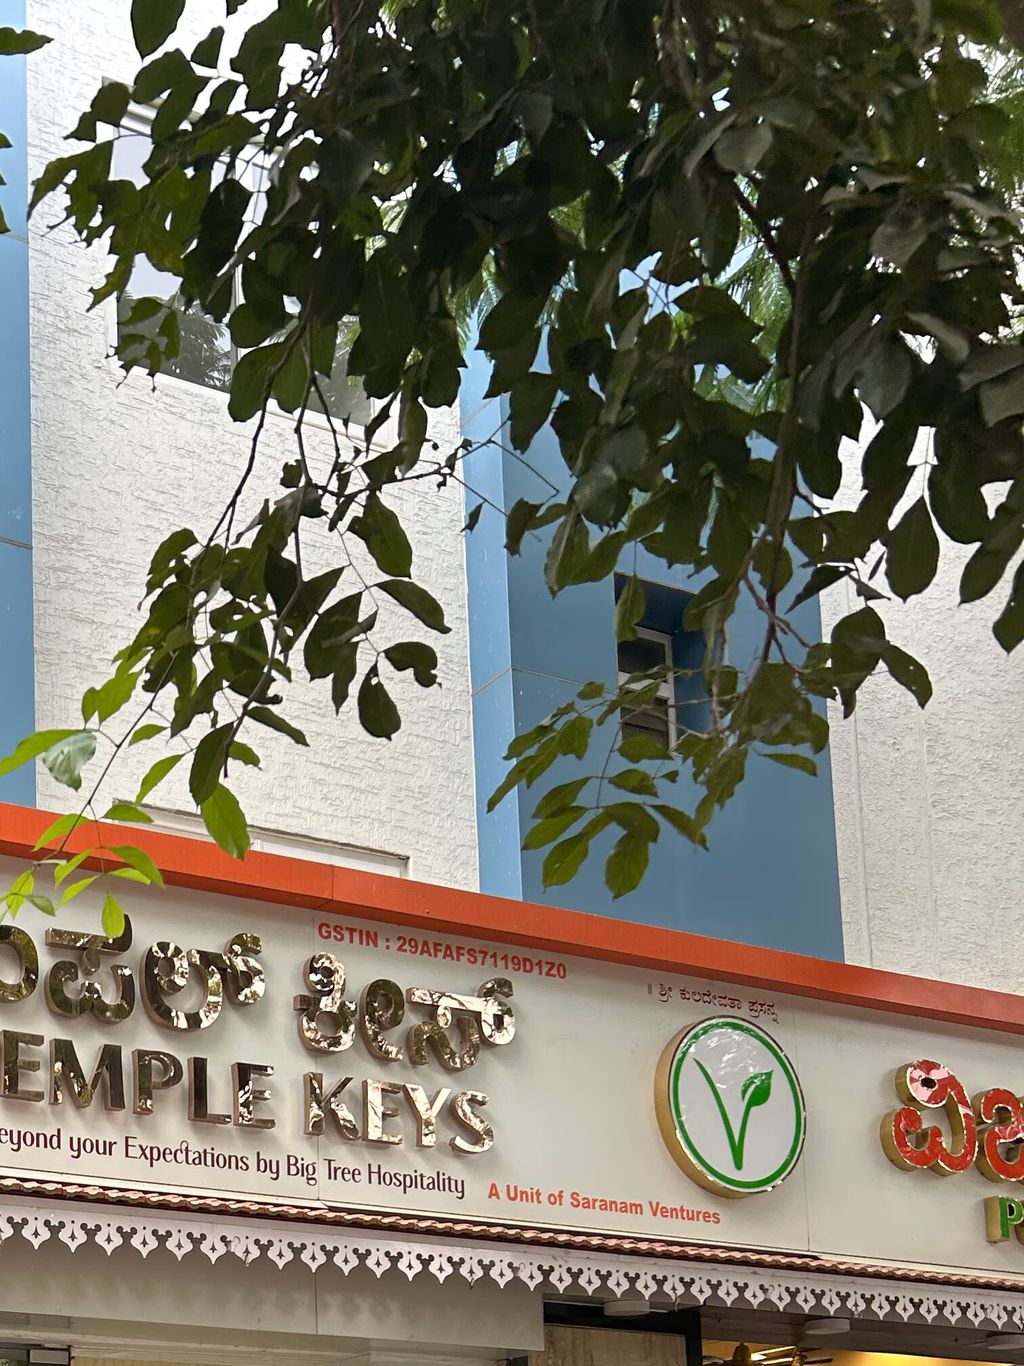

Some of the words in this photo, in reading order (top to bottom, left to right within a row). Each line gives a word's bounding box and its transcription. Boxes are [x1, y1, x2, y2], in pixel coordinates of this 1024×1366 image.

[318, 922, 378, 948] GSTIN
[293, 952, 517, 1071] ಕೀಸ್
[303, 1071, 494, 1154] KEYS
[69, 1135, 117, 1159] your
[125, 1136, 249, 1172] Expectations
[256, 1152, 280, 1181] by
[286, 1155, 318, 1186] Big
[323, 1158, 362, 1183] Tree
[367, 1163, 465, 1199] Hospitality
[488, 1183, 501, 1200] A
[506, 1184, 542, 1204] Unit
[547, 1190, 564, 1207] of
[570, 1191, 644, 1216] Saranam
[648, 1200, 721, 1225] Ventures
